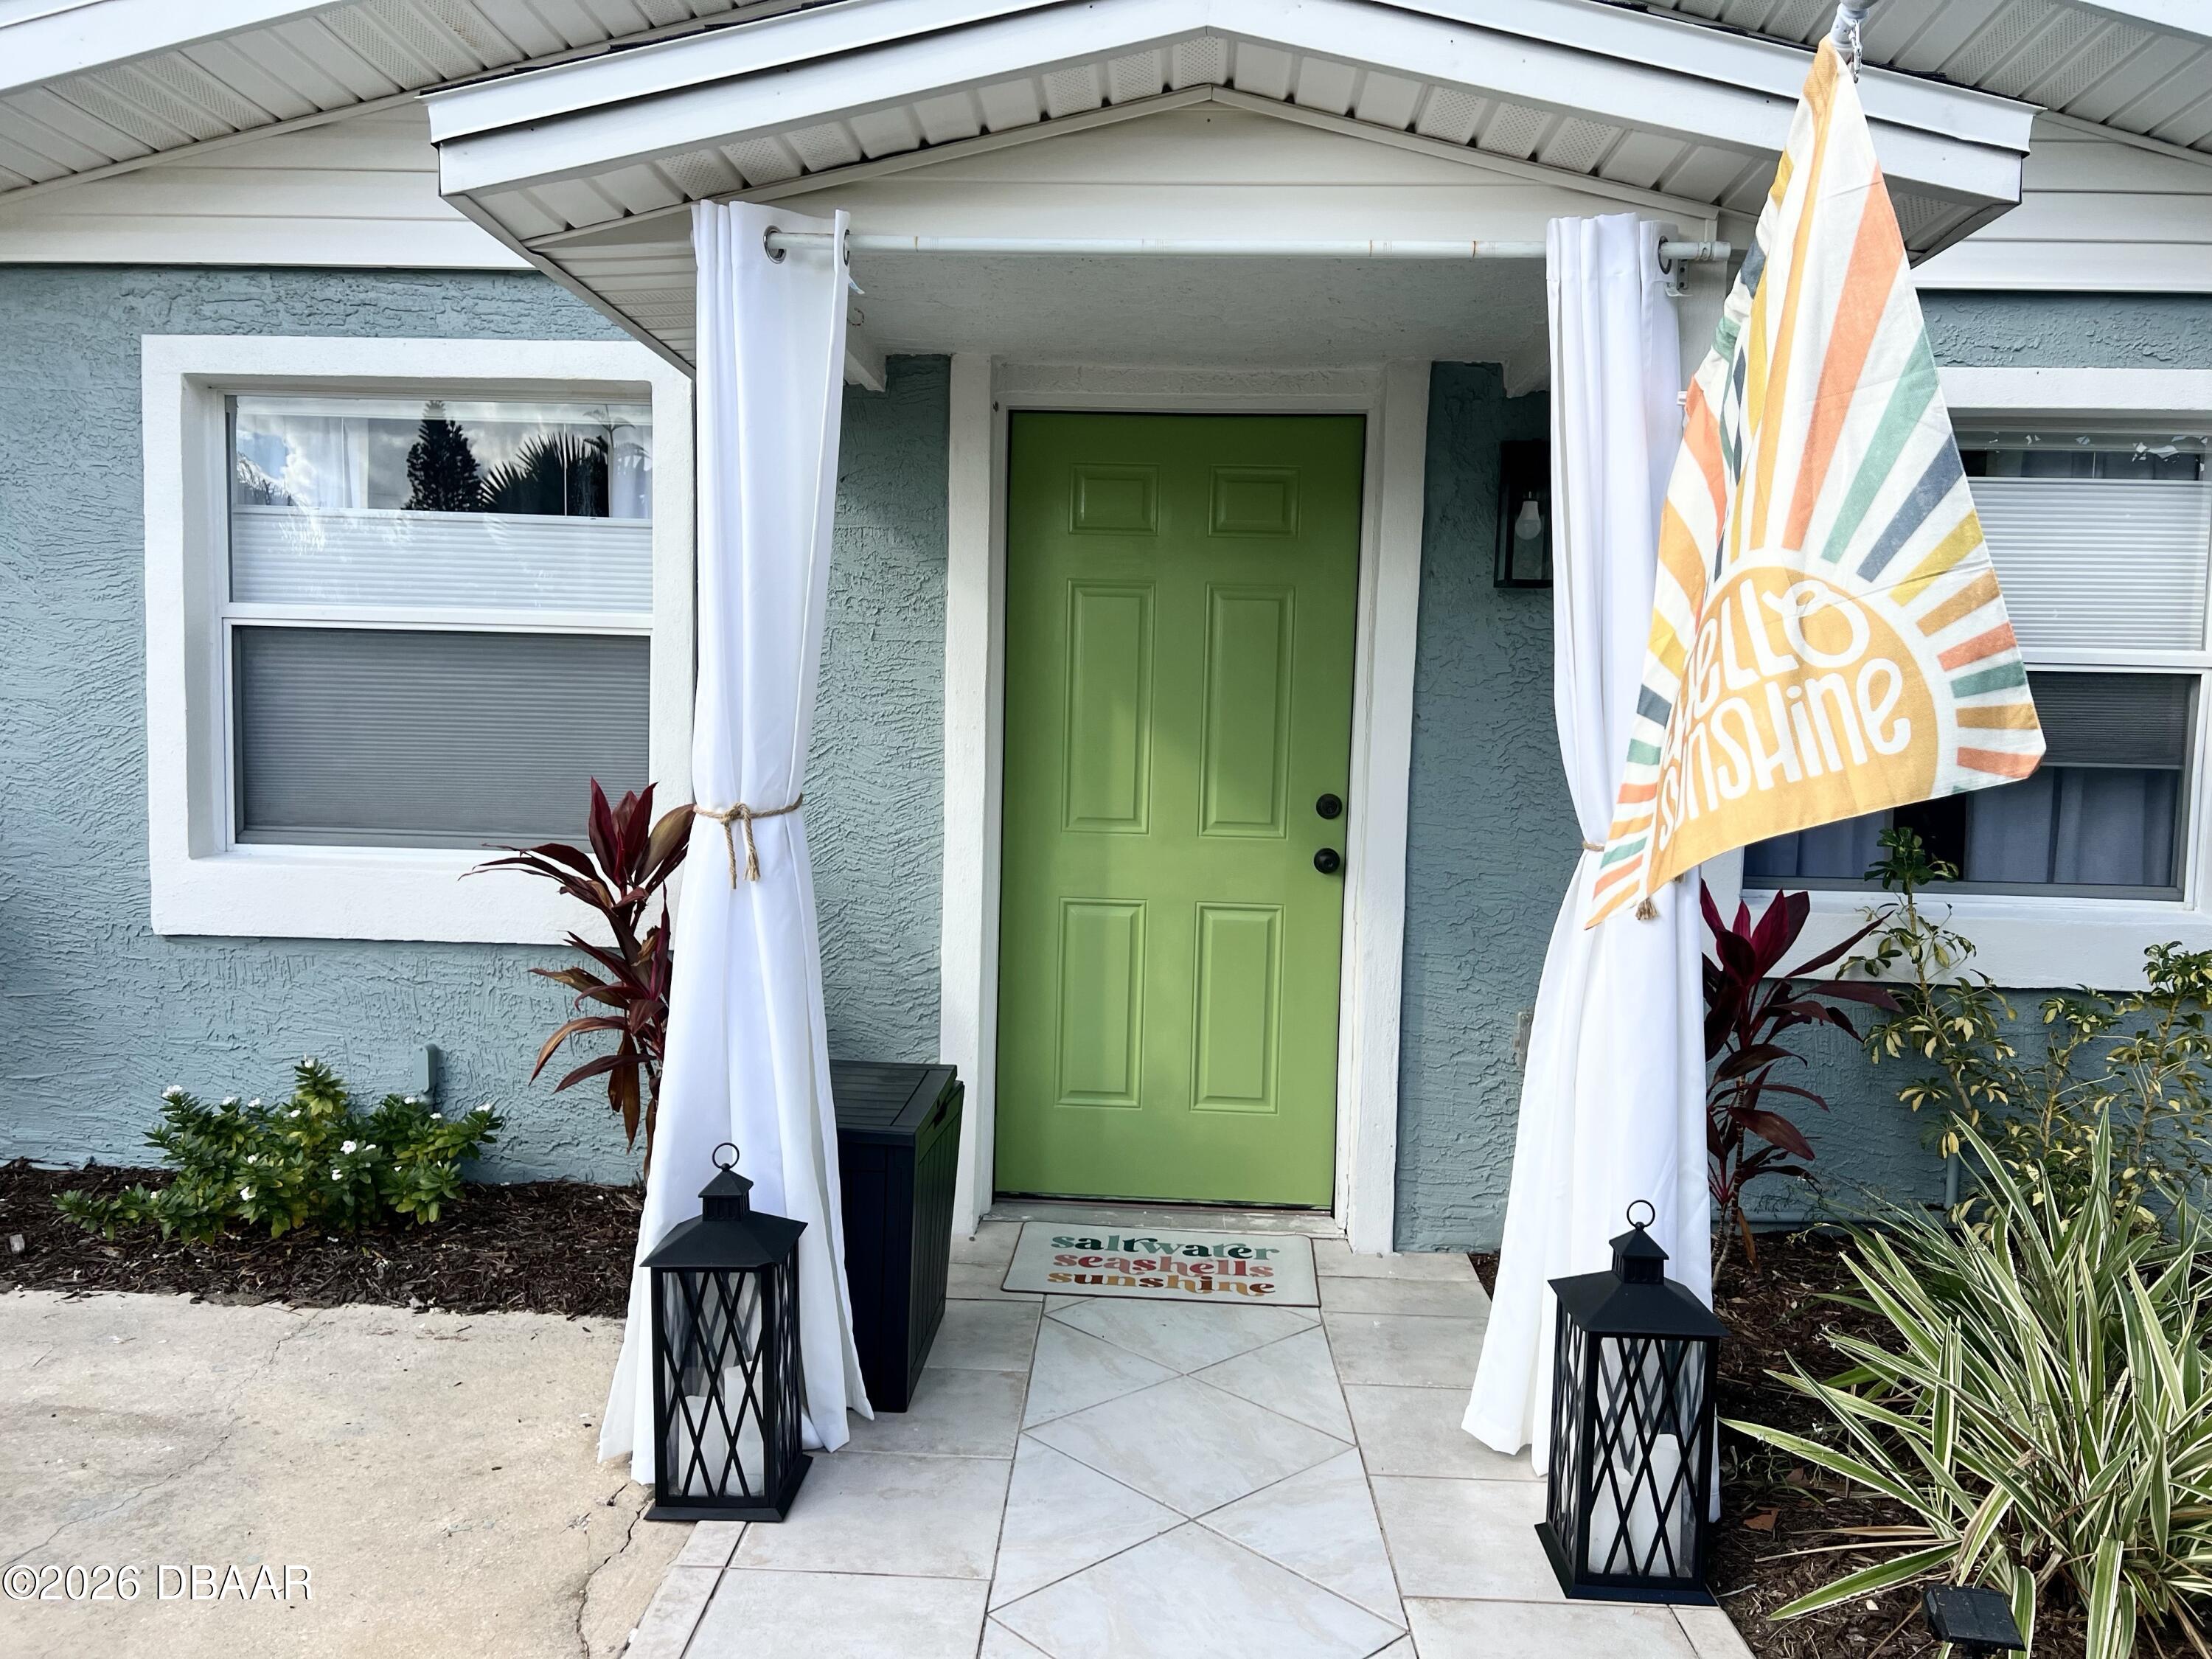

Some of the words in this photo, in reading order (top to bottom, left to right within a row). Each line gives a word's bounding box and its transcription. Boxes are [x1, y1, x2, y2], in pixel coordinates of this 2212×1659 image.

[1051, 1234, 1281, 1261] saltwater
[1053, 1253, 1274, 1278] seashells
[1047, 1272, 1276, 1297] sunshine
